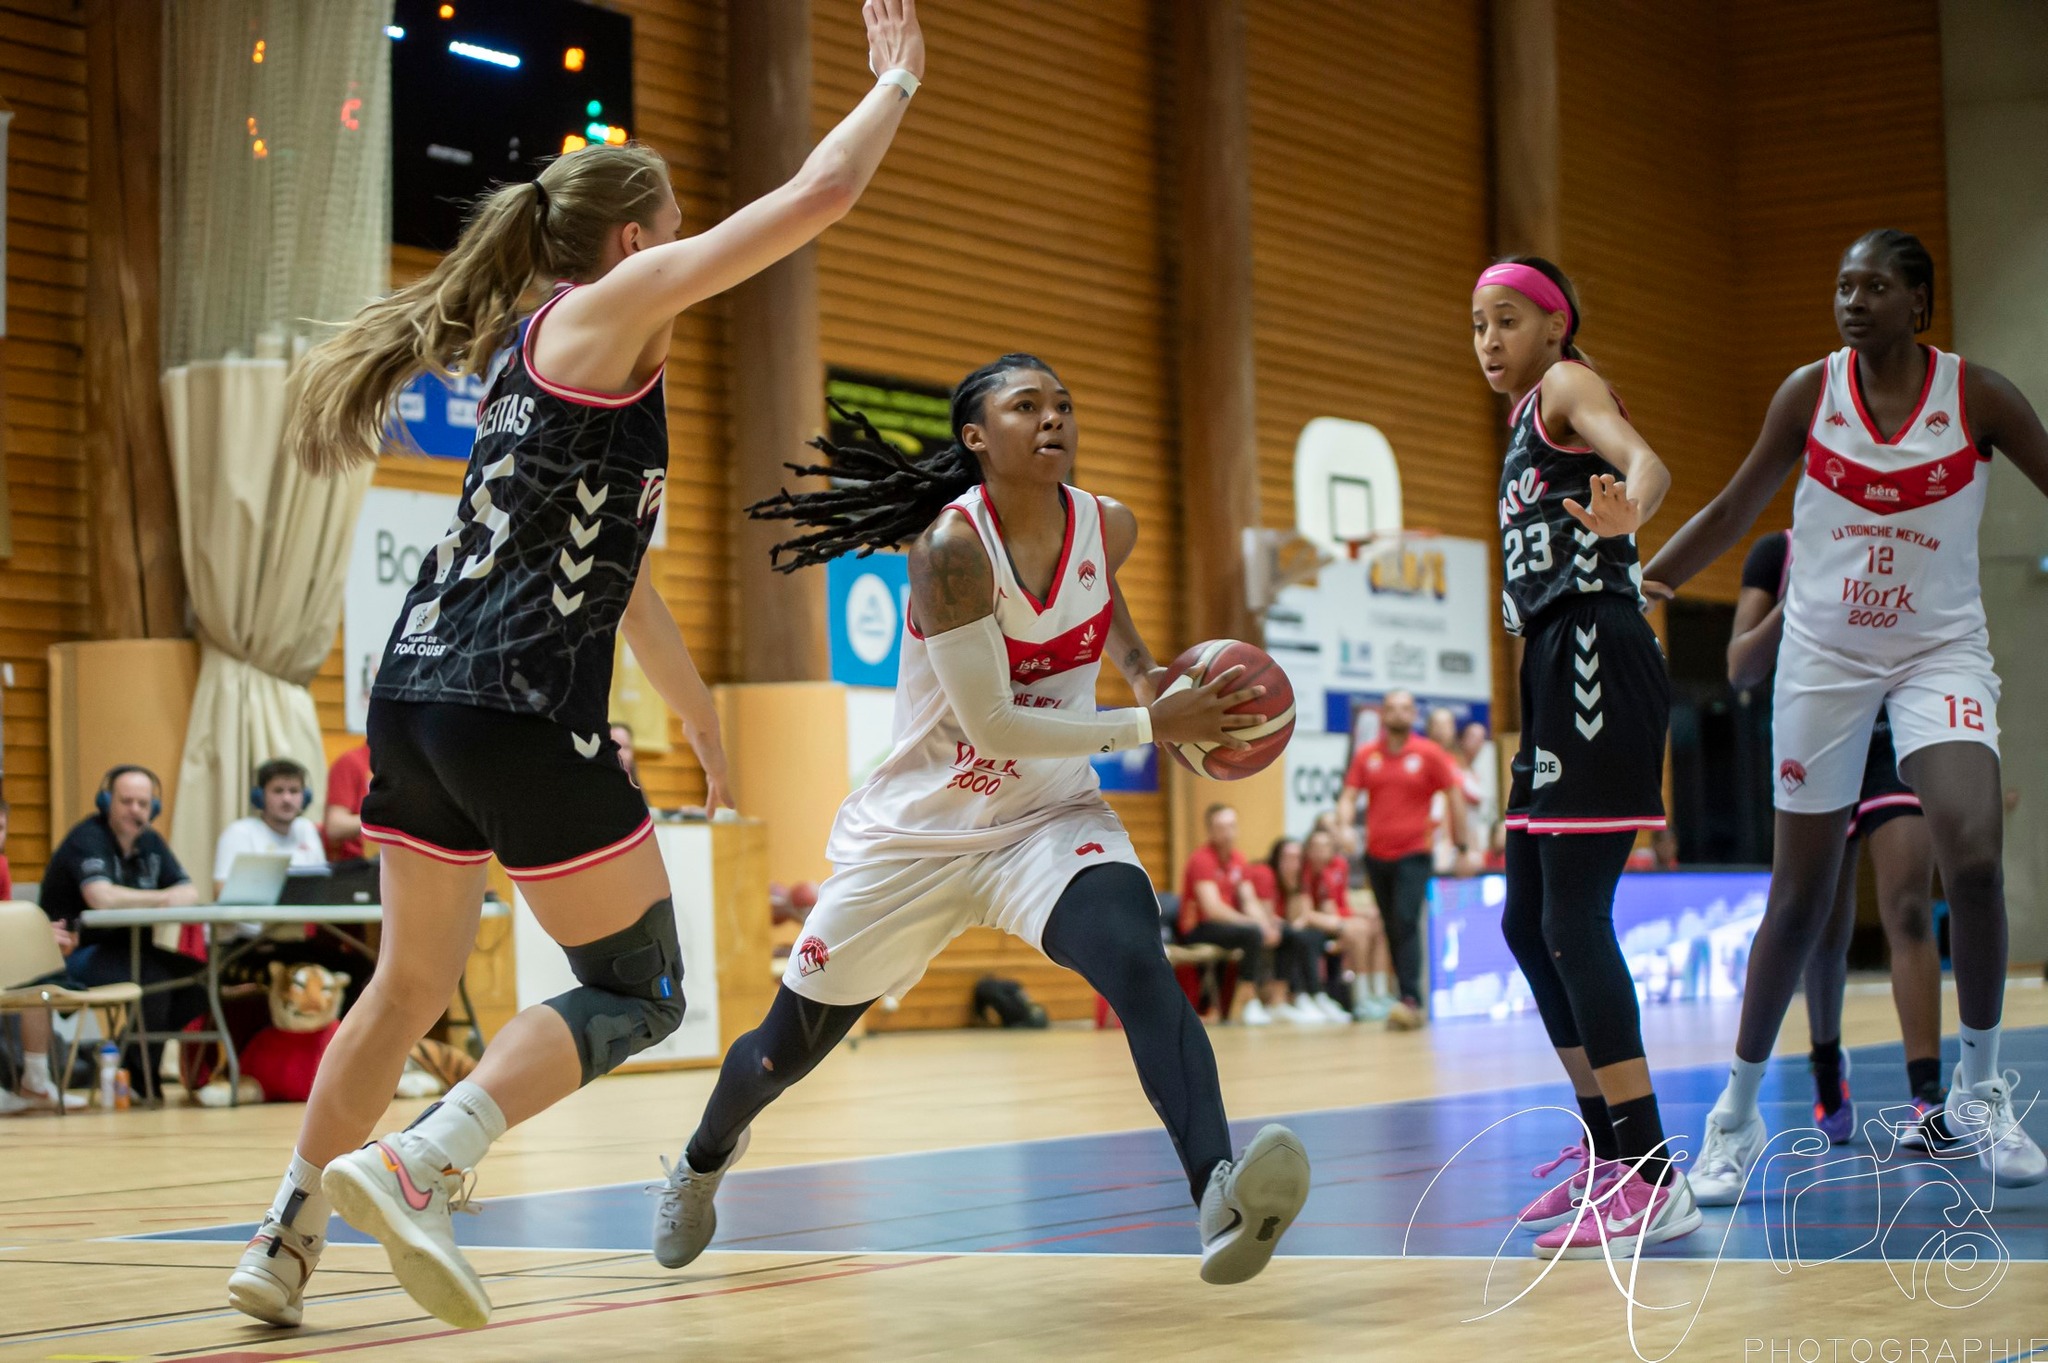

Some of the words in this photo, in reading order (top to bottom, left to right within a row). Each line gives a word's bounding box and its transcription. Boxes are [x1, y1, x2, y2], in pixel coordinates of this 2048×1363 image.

[475, 394, 535, 444] REITAS
[1866, 484, 1899, 497] isère
[1504, 522, 1554, 581] 23
[1831, 528, 1845, 541] LA
[1845, 524, 1894, 538] TRONCHE
[1896, 527, 1941, 552] MEYLAN
[1868, 545, 1894, 575] 12
[1842, 577, 1916, 614] Work
[1848, 608, 1898, 628] 2000
[1019, 658, 1051, 671] isèe
[1944, 694, 1985, 732] 12
